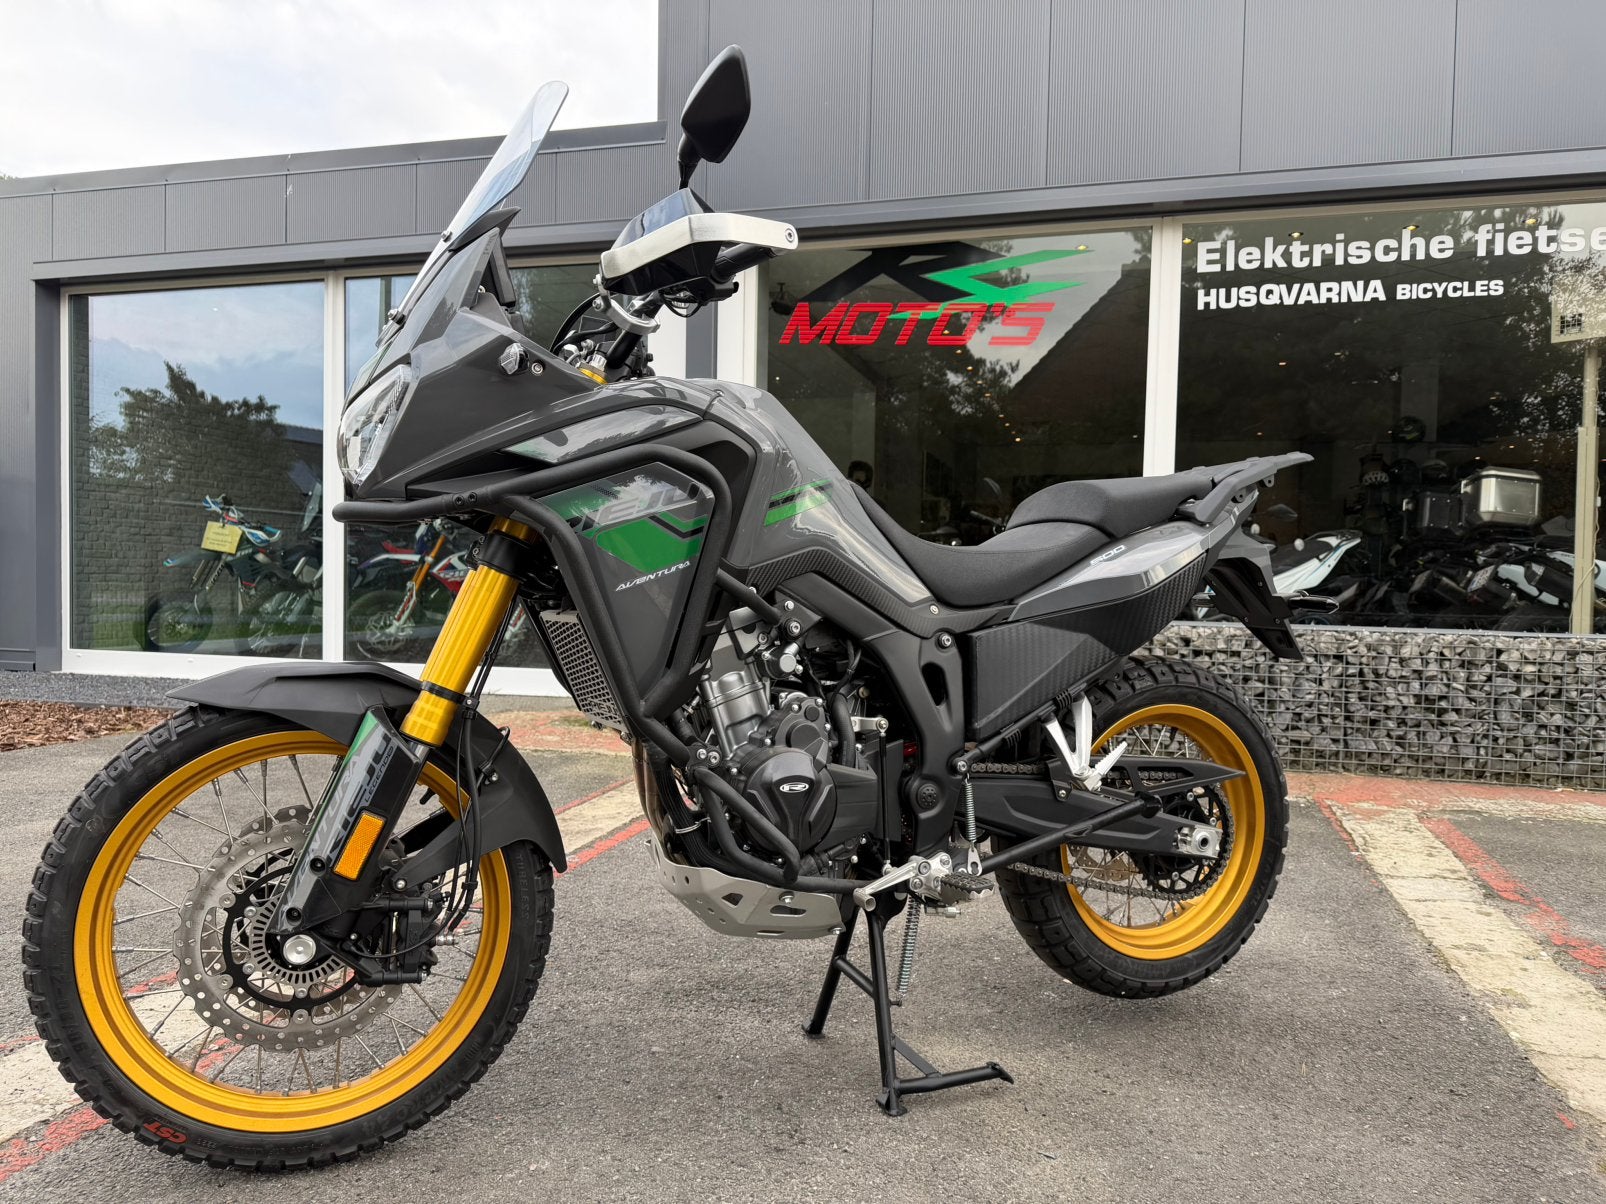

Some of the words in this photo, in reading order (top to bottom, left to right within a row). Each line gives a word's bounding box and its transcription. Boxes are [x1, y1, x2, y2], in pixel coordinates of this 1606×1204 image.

[1197, 228, 1454, 273] Elektrische
[1197, 279, 1386, 310] HUSQVARNA
[1396, 279, 1504, 301] BICYCLES
[779, 302, 1056, 346] MOTO'S
[1090, 544, 1125, 567] 500
[615, 560, 690, 592] AVENTURA
[143, 1121, 187, 1145] CST
